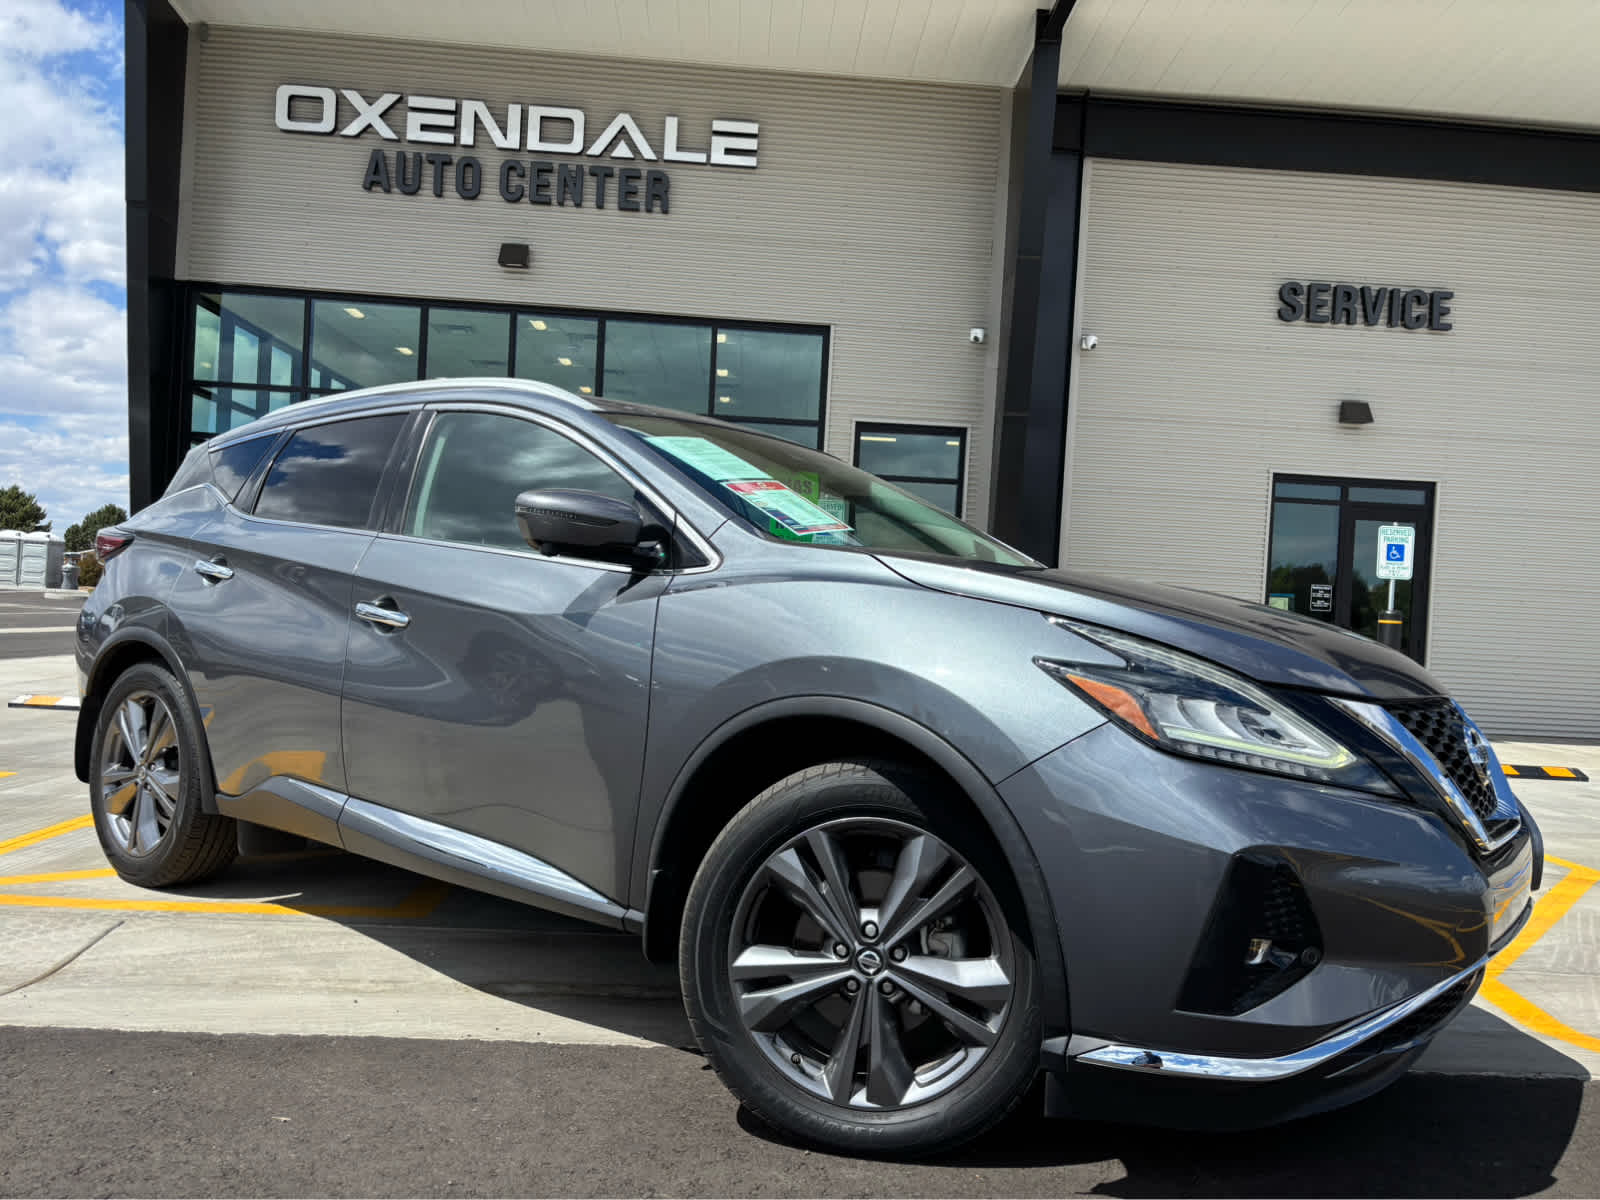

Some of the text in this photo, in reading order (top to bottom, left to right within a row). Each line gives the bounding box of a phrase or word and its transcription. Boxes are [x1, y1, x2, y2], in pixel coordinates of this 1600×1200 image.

[275, 84, 759, 168] OXENDALE
[362, 149, 671, 214] AUTO CENTER
[1277, 281, 1454, 331] SERVICE
